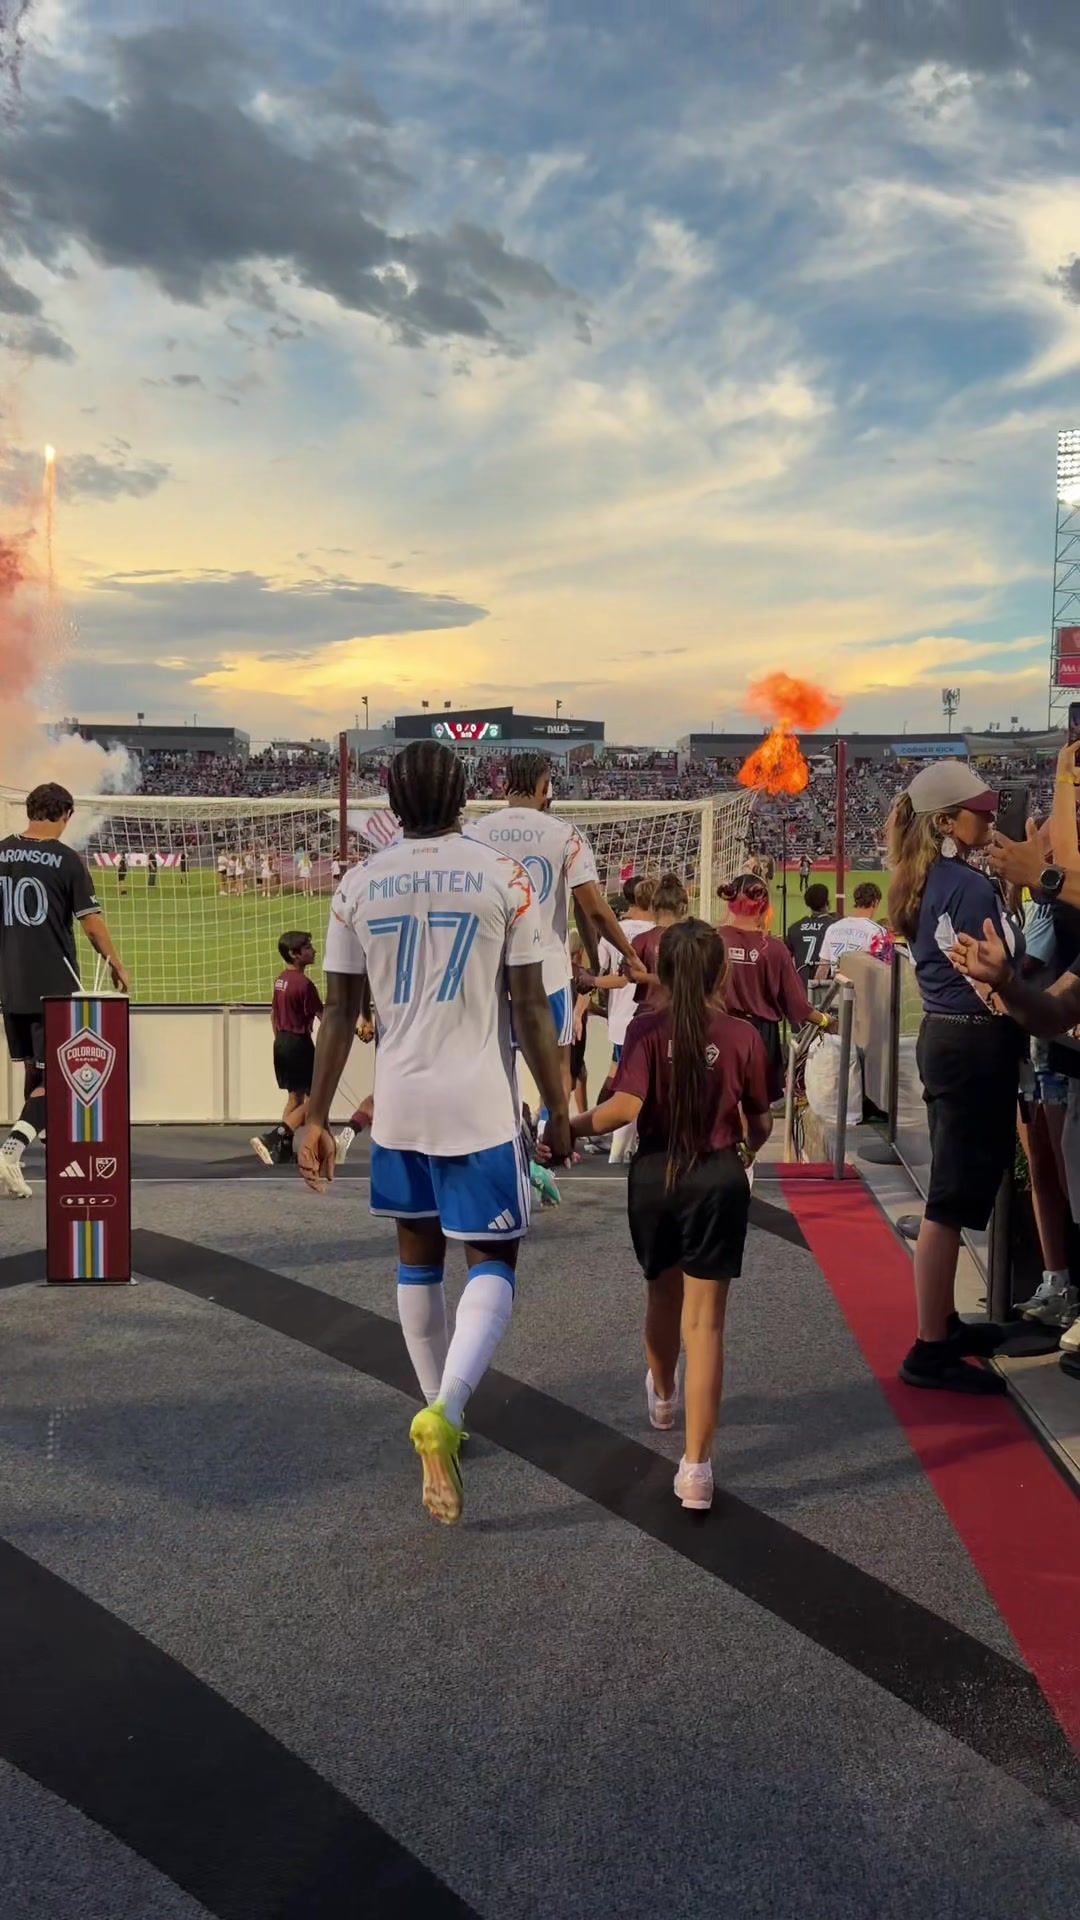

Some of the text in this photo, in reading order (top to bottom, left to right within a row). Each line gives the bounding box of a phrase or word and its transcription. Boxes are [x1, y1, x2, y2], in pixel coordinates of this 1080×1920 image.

[489, 829, 545, 843] GODOY
[369, 870, 484, 901] MIGHTEN
[0, 876, 49, 927] 10
[801, 922, 824, 931] SEALY
[367, 911, 480, 1005] 77
[802, 935, 817, 965] 7
[67, 1046, 107, 1060] COLORADO
